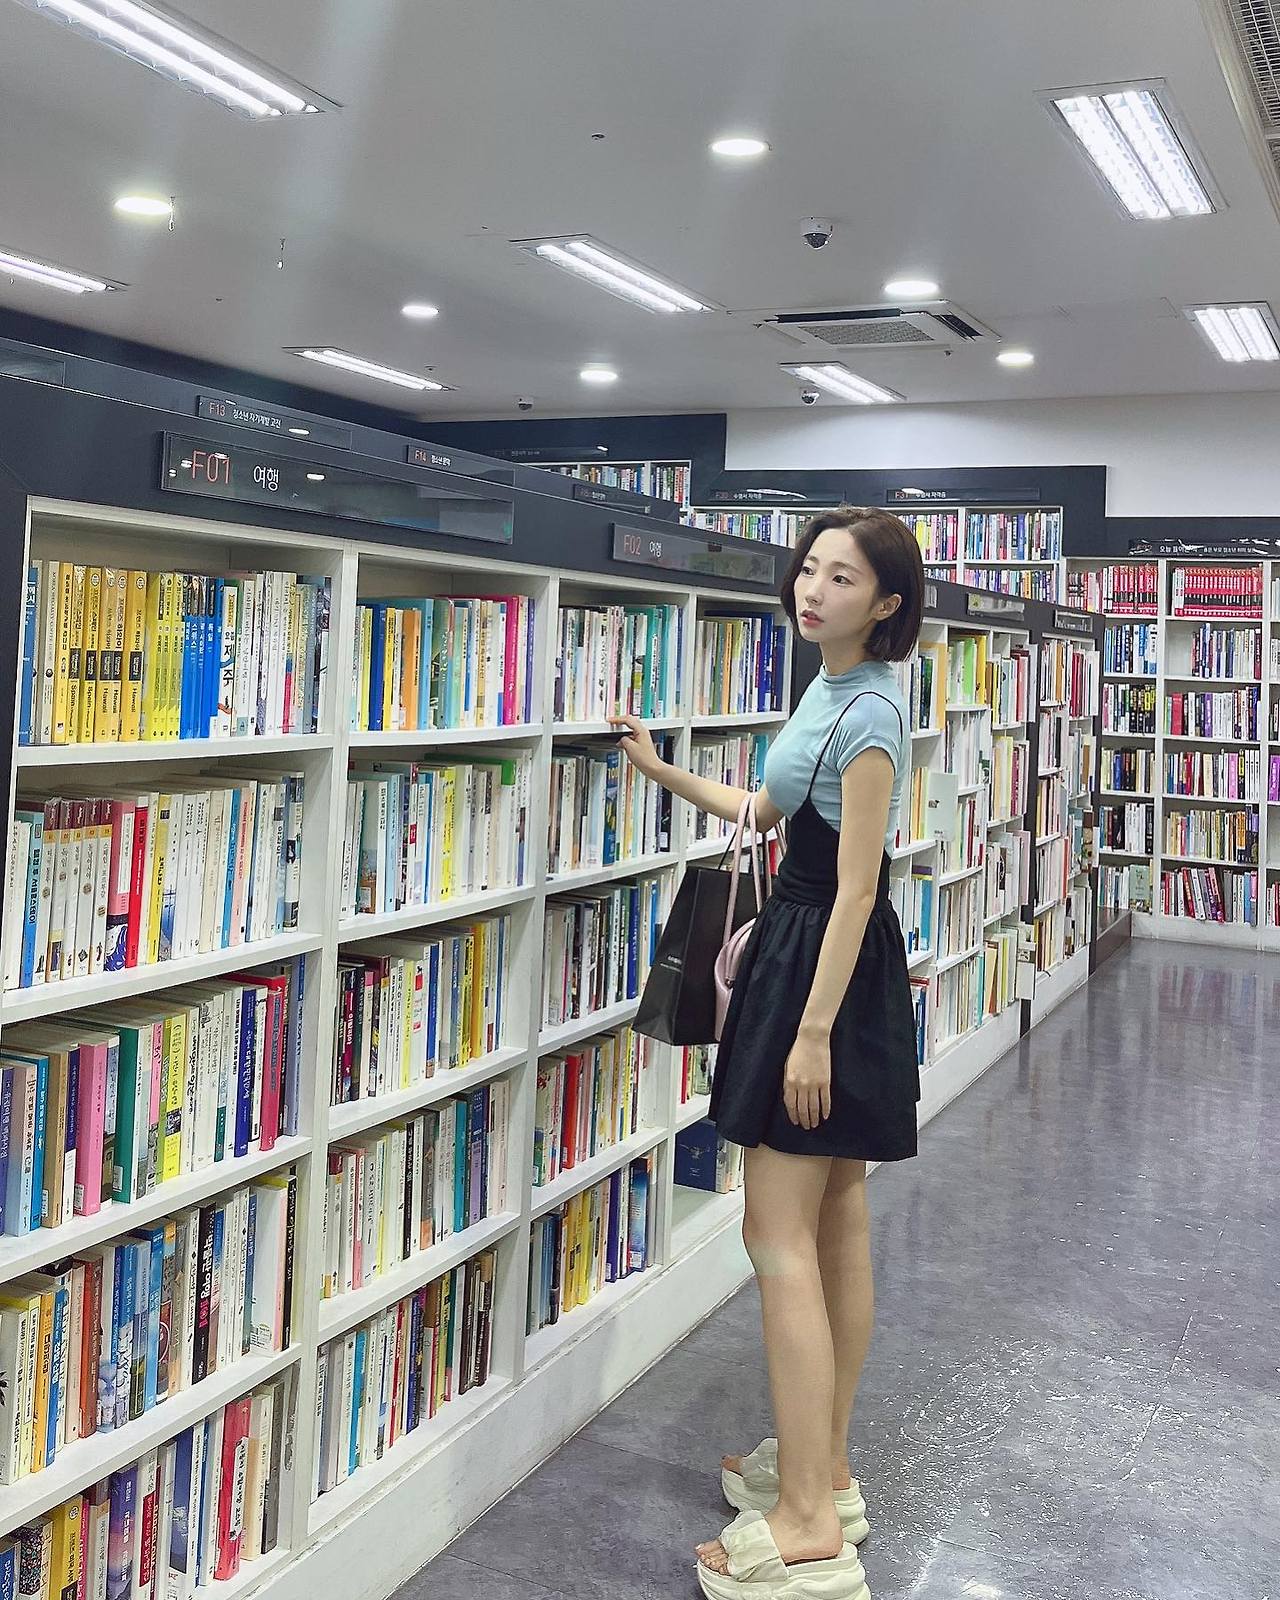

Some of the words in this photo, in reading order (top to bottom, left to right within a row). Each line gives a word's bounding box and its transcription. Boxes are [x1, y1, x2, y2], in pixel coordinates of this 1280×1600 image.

[191, 450, 231, 484] F01
[253, 465, 279, 491] 여행
[624, 534, 641, 556] F02
[69, 684, 77, 706] Spain
[84, 686, 93, 708] Spain
[101, 688, 109, 713] Hawaii
[111, 689, 119, 714] Hawaii
